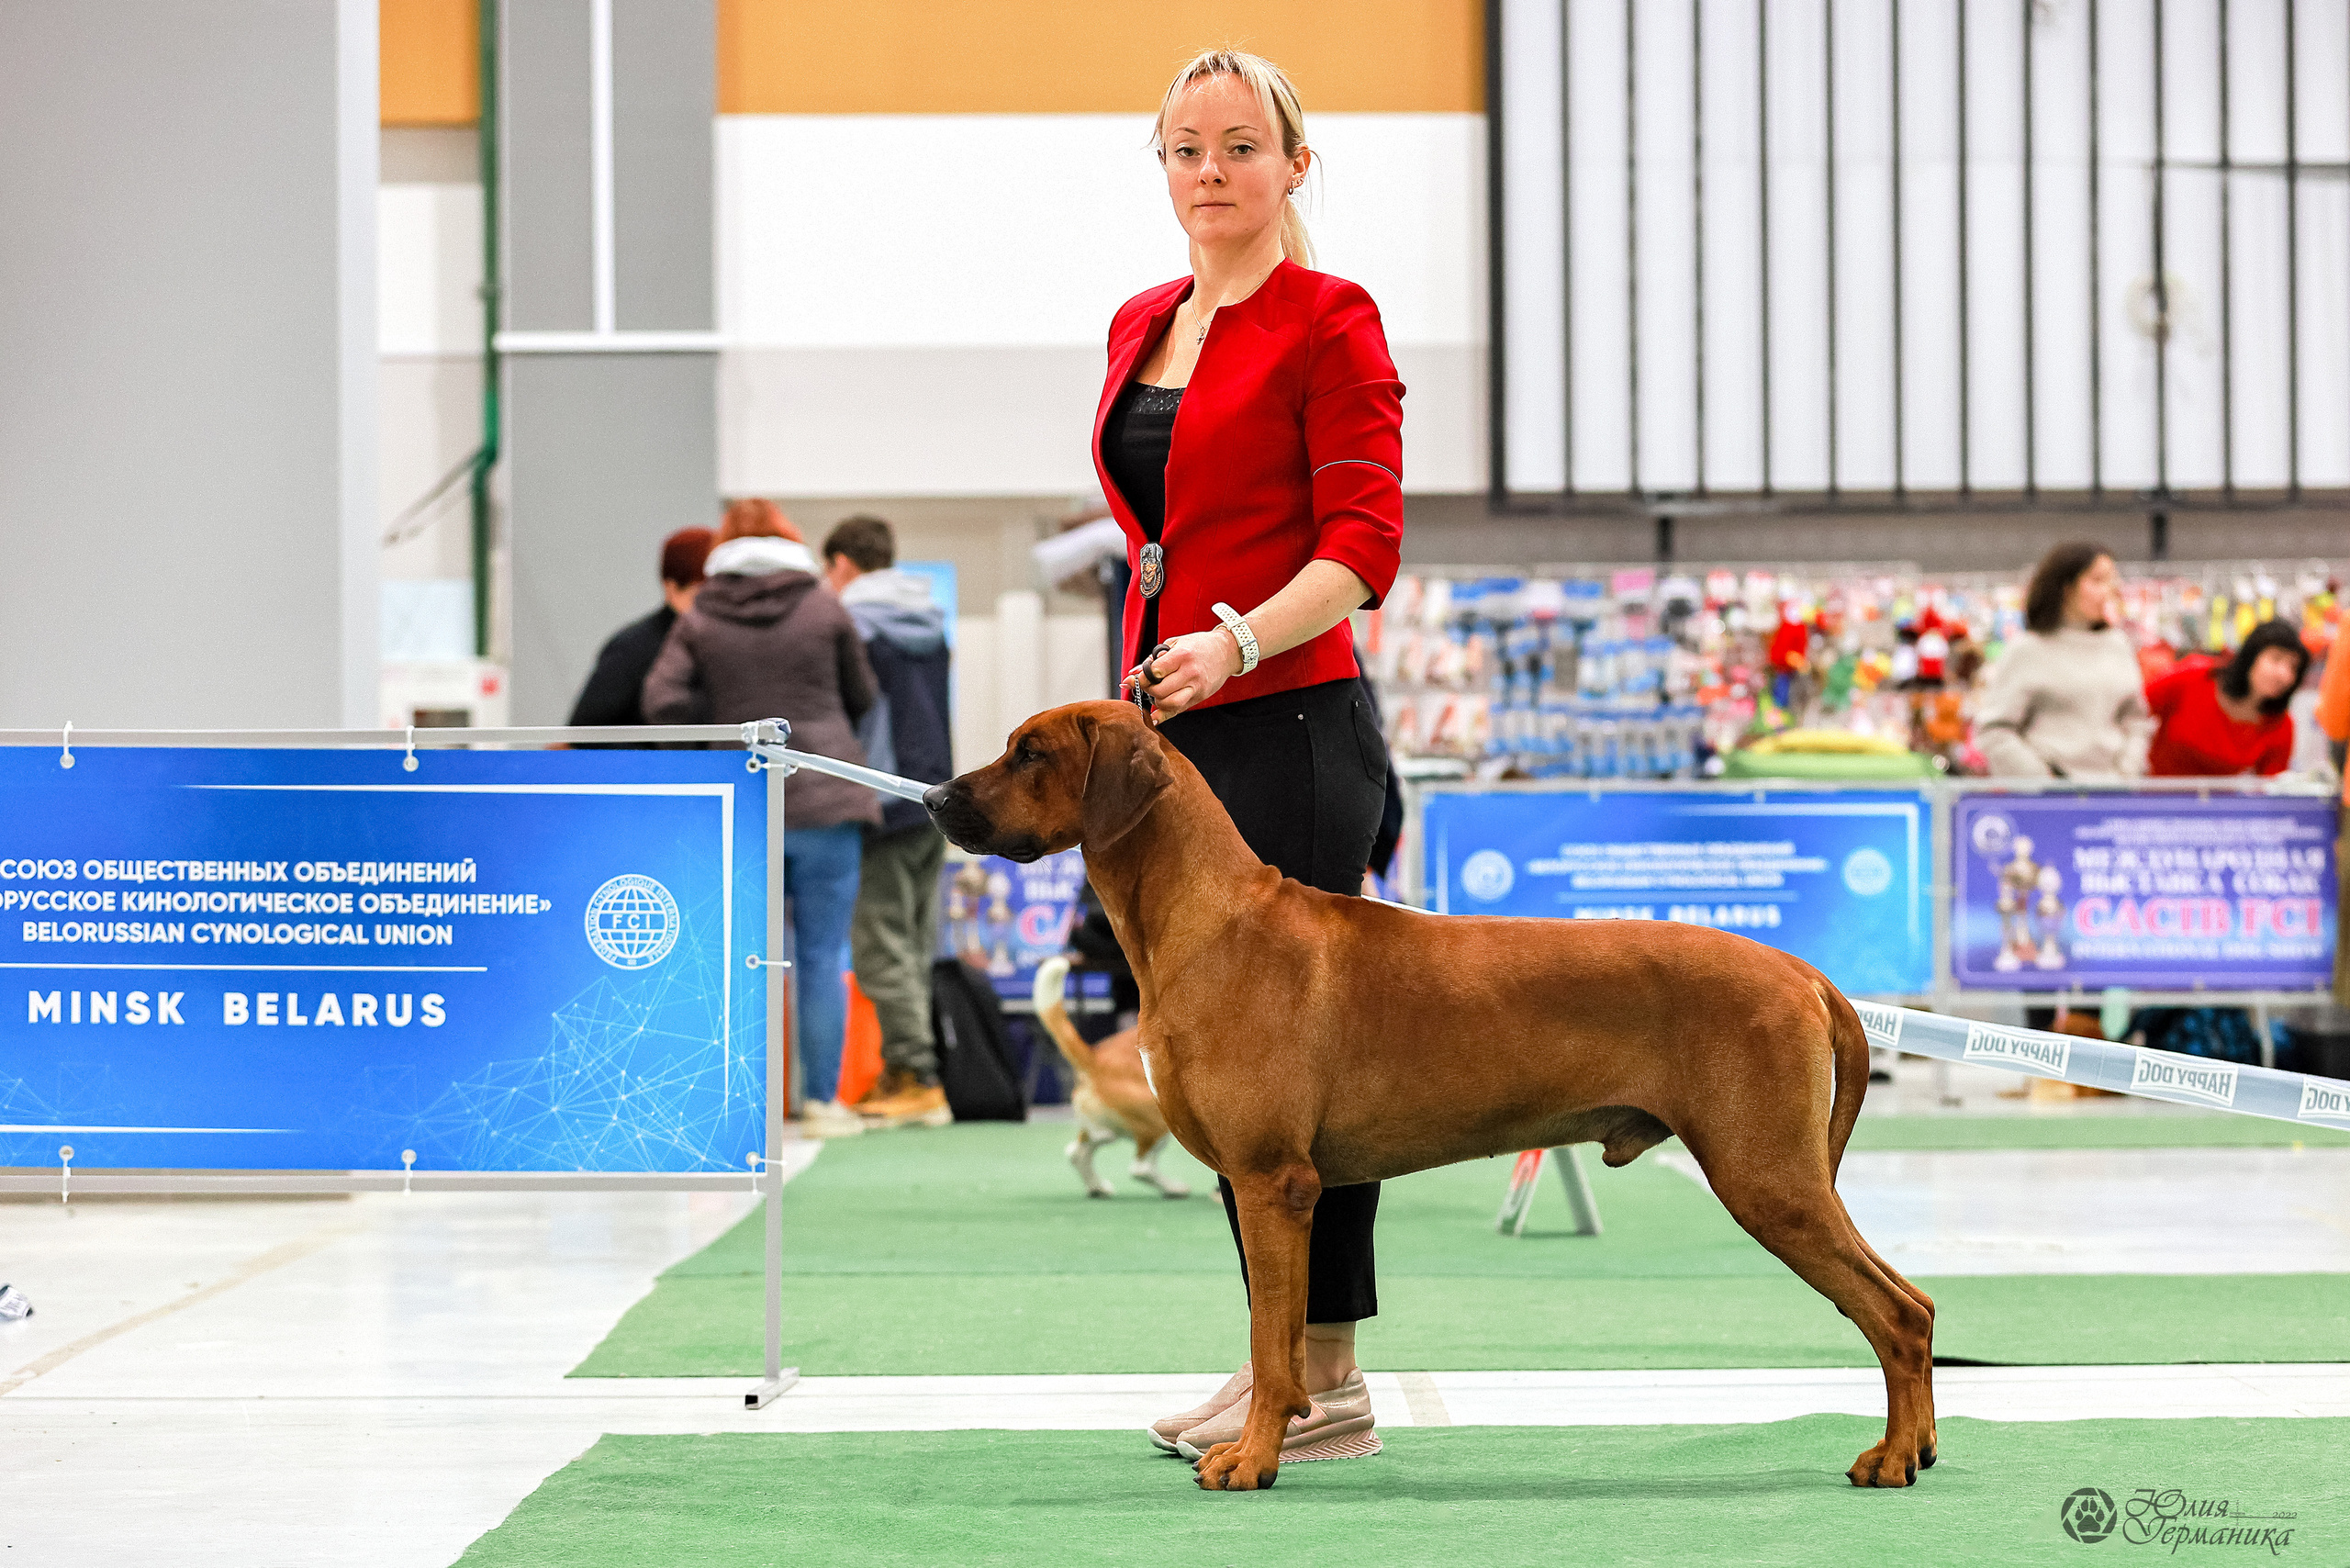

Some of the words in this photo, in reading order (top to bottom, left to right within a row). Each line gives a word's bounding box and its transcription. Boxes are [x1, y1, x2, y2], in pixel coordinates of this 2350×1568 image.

[0, 858, 77, 879] СОЮЗ
[83, 859, 288, 883] ОБЩЕСТВЕННЫХ
[293, 857, 476, 886] ОБЪЕДИНЕНИЙ
[0, 890, 116, 912] РУССКОЕ
[122, 891, 353, 913] КИНОЛОГИЧЕСКОЕ
[359, 893, 552, 917] ОБЪЕДИНЕНИЕ»
[2076, 898, 2230, 937] CACIB
[23, 922, 185, 943] BELORUSSIAN
[191, 923, 369, 945] CYNOLOGICAL
[375, 924, 453, 946] UNION
[612, 914, 650, 929] FCI
[28, 991, 185, 1025] MINSK
[223, 992, 446, 1027] BELARUS
